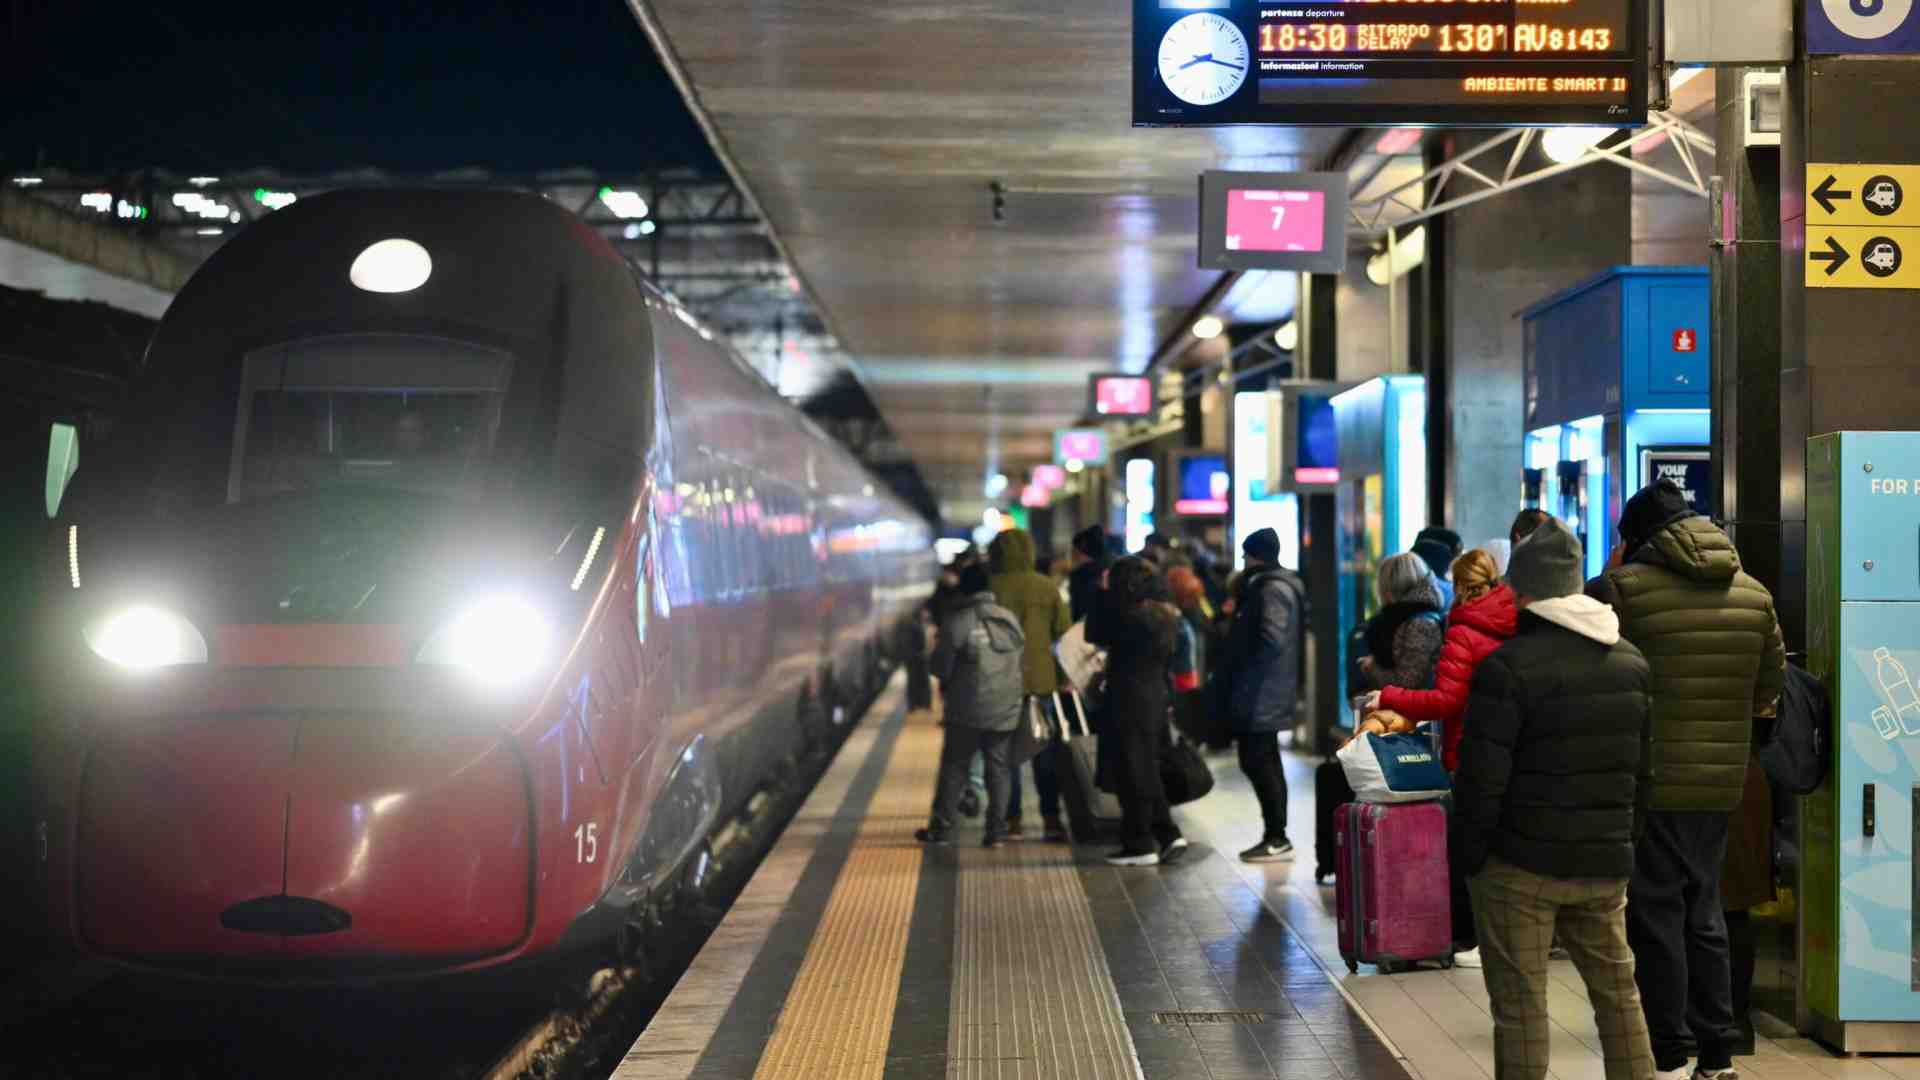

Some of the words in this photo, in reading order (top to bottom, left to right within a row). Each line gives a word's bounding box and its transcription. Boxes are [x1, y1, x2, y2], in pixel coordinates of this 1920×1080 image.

[1261, 9, 1303, 18] partenza
[1305, 8, 1345, 18] departure
[1260, 24, 1345, 51] 18:30
[1357, 25, 1430, 38] RITARDO
[1357, 37, 1411, 49] DELAY
[1261, 62, 1319, 70] informazioni
[1321, 62, 1364, 70] information
[1465, 78, 1548, 91] AMBIENTE
[1553, 78, 1607, 91] SMART
[1613, 78, 1626, 91] I
[1271, 206, 1285, 230] 7
[1872, 479, 1907, 495] FOR
[575, 823, 597, 863] 15
